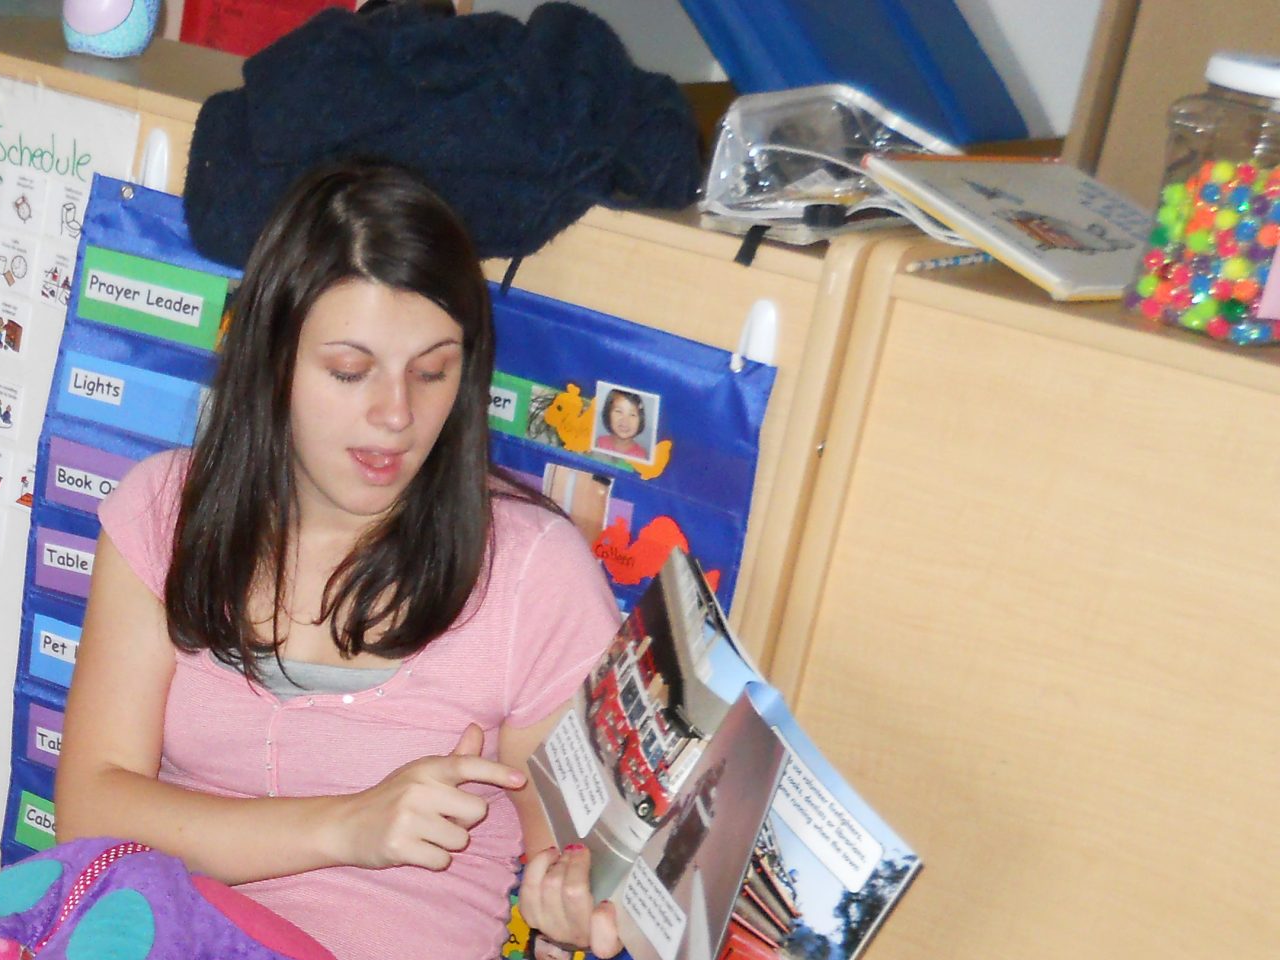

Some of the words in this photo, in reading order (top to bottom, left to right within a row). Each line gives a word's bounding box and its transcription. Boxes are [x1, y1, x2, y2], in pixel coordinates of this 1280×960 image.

[89, 275, 140, 302] Prayer
[146, 290, 200, 316] Leader
[73, 373, 121, 398] Lights
[492, 396, 511, 409] er
[57, 468, 92, 491] Book
[46, 548, 89, 571] Table
[43, 635, 67, 654] Pet
